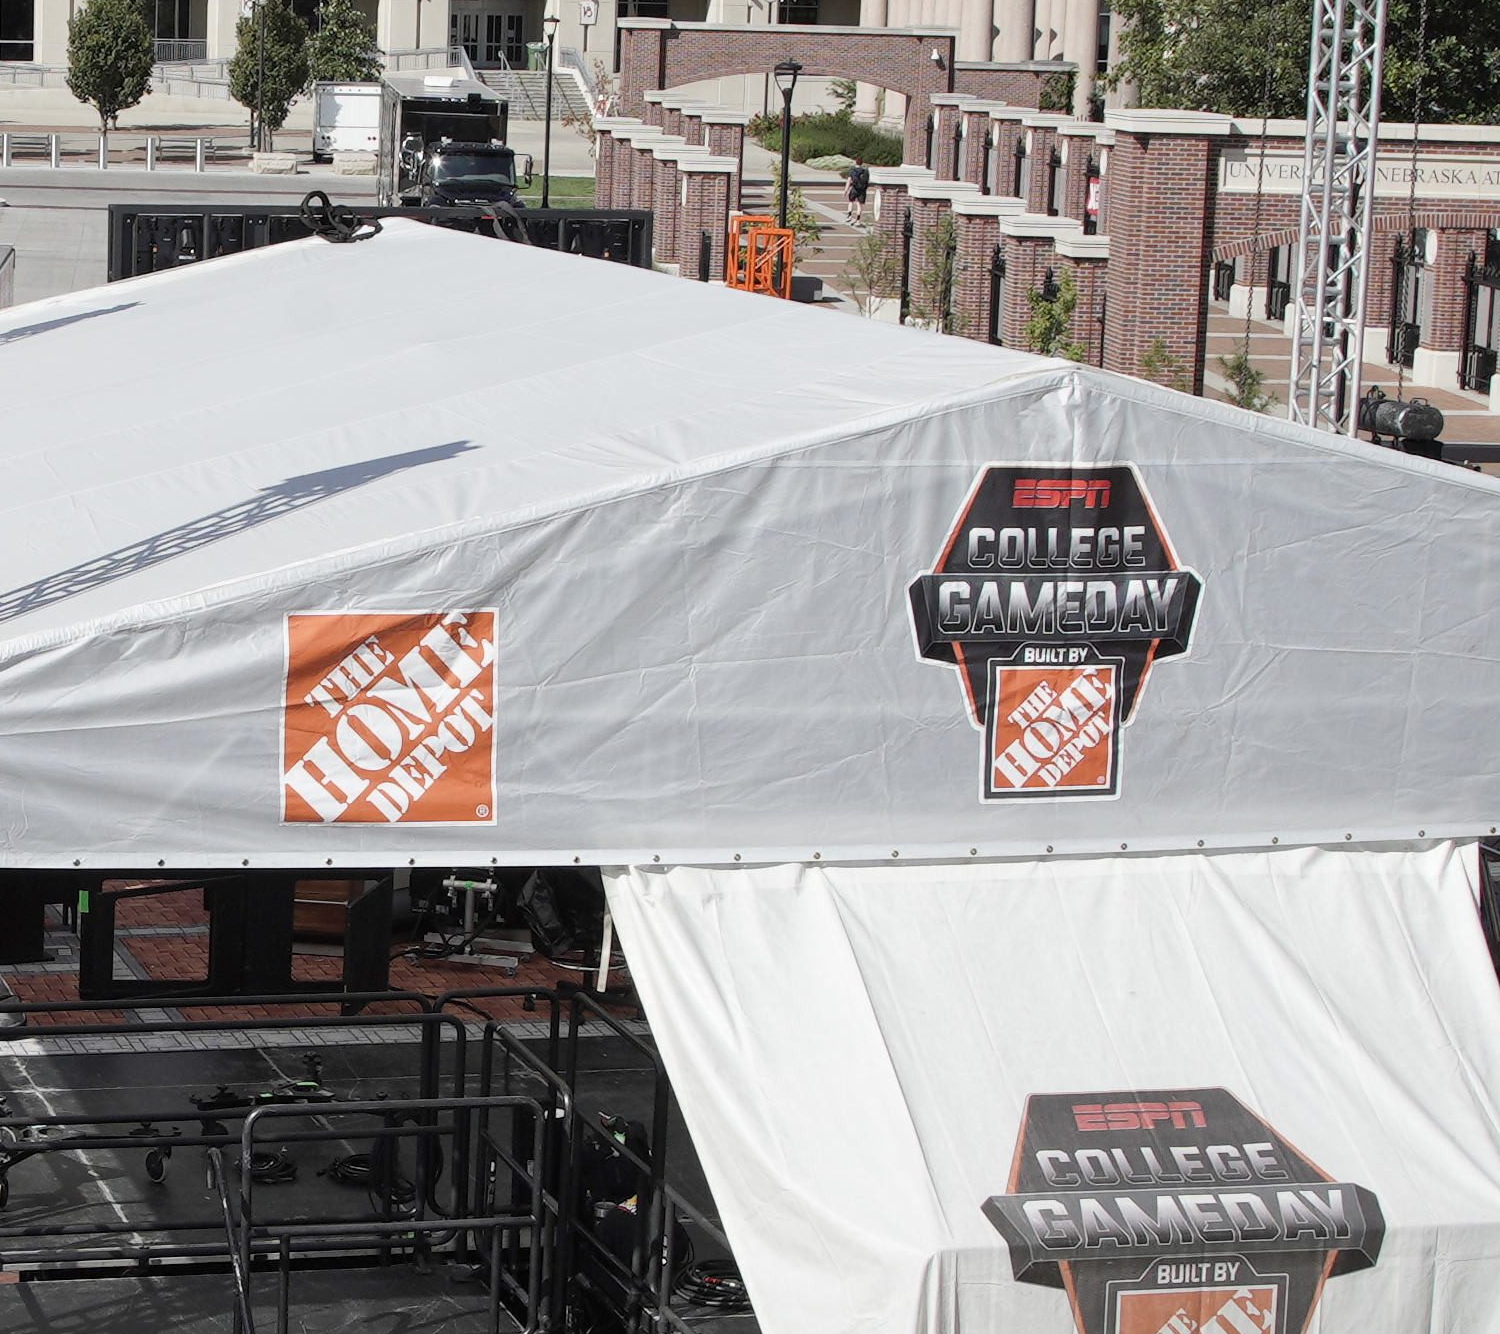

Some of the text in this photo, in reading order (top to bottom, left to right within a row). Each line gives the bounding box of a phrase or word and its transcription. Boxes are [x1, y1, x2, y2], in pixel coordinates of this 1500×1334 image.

[1376, 167, 1477, 185] NEBRASKA
[1011, 479, 1112, 508] ESPN
[967, 525, 1147, 569] COLLEGE
[937, 577, 1179, 635] GAMEDAY
[304, 635, 395, 718] THE
[1024, 647, 1088, 663] BUILT BY
[283, 613, 496, 823] HOME
[994, 667, 1113, 788] HOME
[1007, 680, 1058, 731] THE
[365, 689, 493, 823] DEPOT
[1037, 711, 1113, 787] DEPOT
[1071, 1100, 1208, 1132] ESPN
[1034, 1141, 1289, 1187] COLLEGE
[1022, 1189, 1353, 1251] GAMEDAY
[1157, 1261, 1240, 1284] BUILT BY
